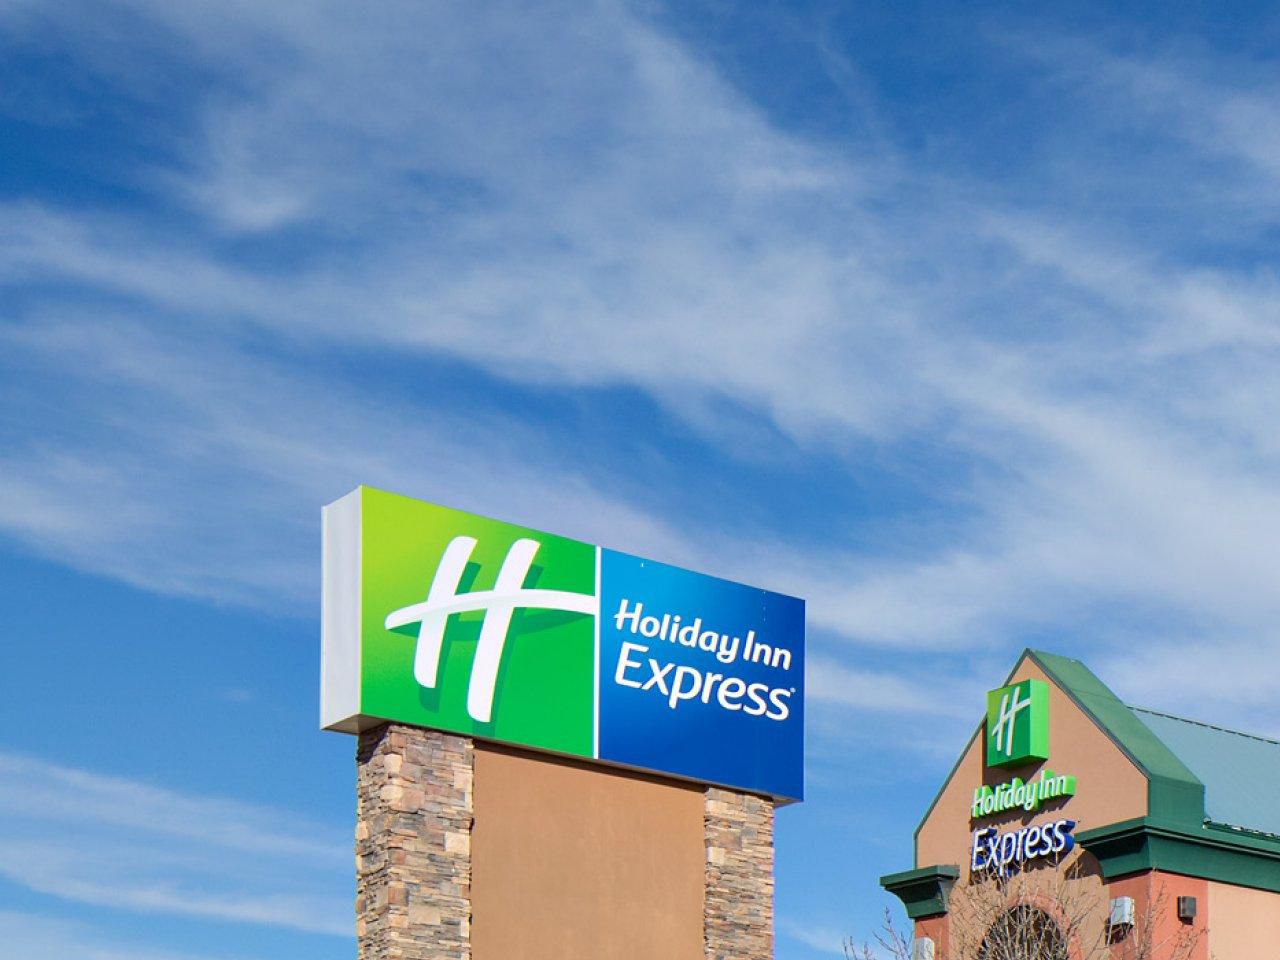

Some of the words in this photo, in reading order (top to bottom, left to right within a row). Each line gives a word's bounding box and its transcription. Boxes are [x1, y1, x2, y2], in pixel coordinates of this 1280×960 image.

[613, 599, 740, 664] Holiday
[743, 630, 792, 670] Inn
[614, 641, 789, 721] Express
[972, 777, 1039, 818] Holiday
[1039, 769, 1070, 800] Inn
[971, 820, 1070, 877] Express
